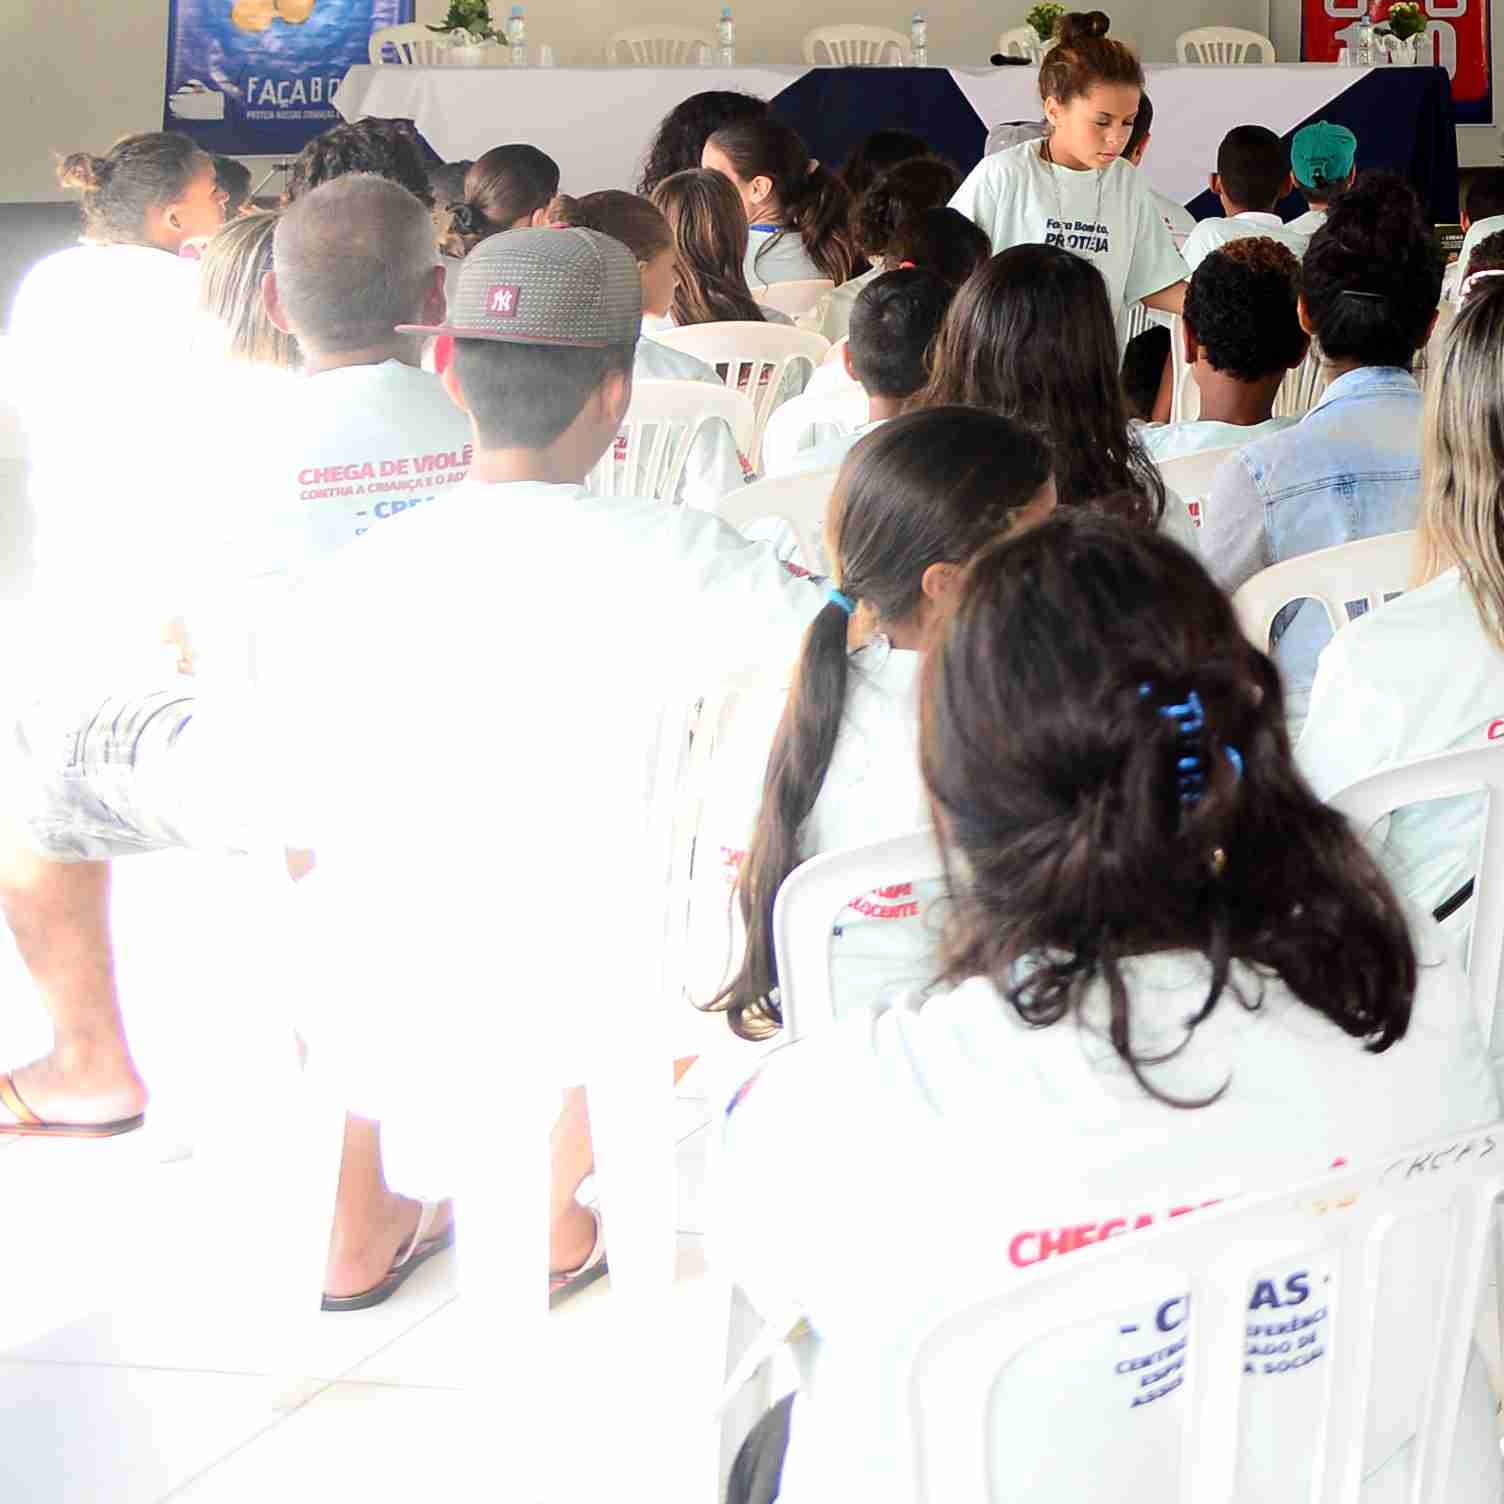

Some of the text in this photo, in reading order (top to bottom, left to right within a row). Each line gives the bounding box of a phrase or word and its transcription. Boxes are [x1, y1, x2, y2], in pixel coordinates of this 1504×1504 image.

[1334, 19, 1457, 80] 10
[297, 444, 474, 485] CHEGA DE VIOLÊ
[300, 485, 354, 501] CONTRA
[1156, 1269, 1312, 1333] CAS
